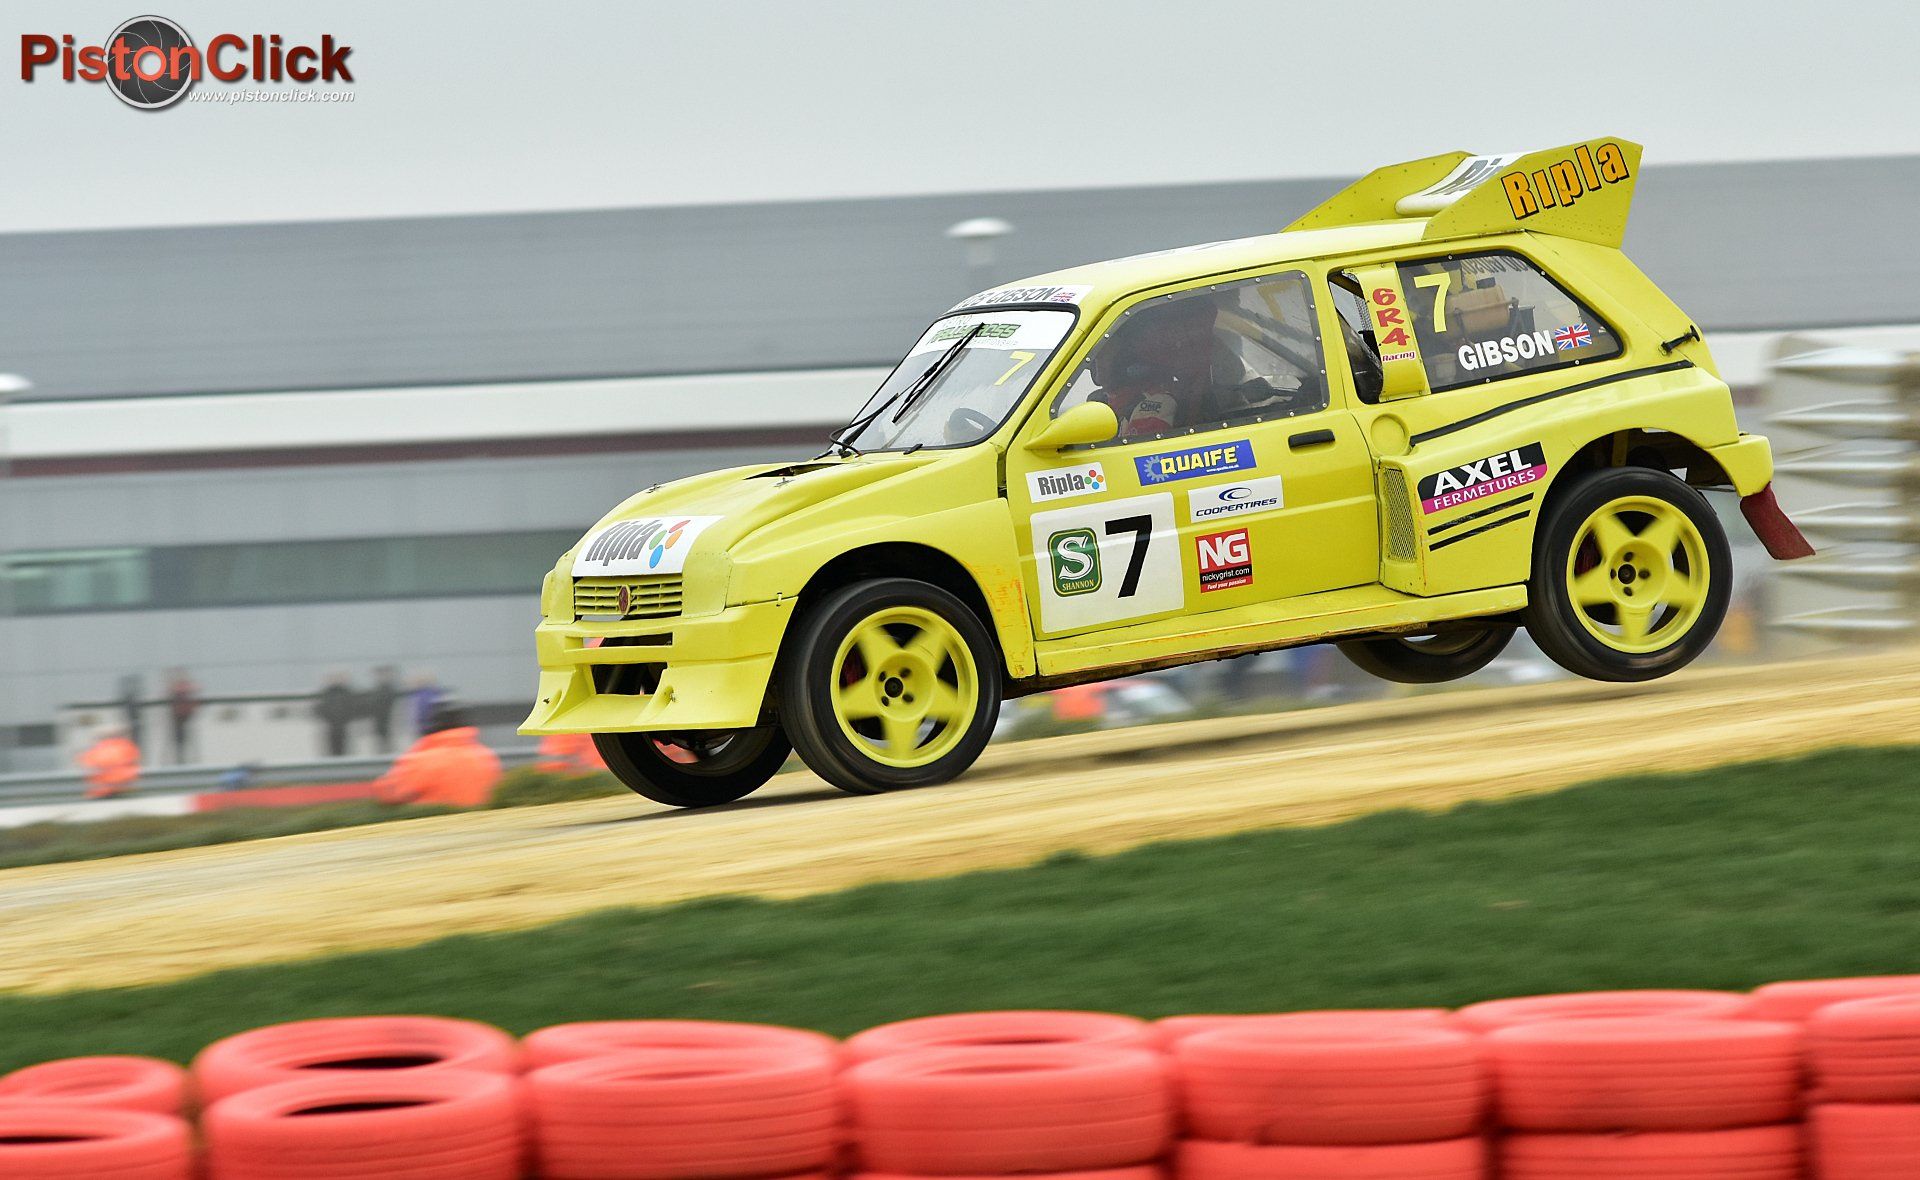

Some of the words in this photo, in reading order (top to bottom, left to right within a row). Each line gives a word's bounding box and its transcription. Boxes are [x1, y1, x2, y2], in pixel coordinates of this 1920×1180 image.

[1501, 143, 1630, 220] Ripla
[986, 287, 1063, 304] GIBSON
[1413, 272, 1451, 333] 7
[1372, 288, 1411, 346] 6R4
[994, 351, 1036, 386] 7
[1382, 351, 1415, 362] Racing
[1458, 330, 1555, 371] GIBSON
[1160, 447, 1238, 475] QUAIFE
[1433, 450, 1532, 497] AXEL
[1037, 473, 1085, 496] Ripla
[1433, 470, 1536, 510] FERMETURES
[585, 519, 664, 566] Ripla
[1057, 536, 1093, 580] S
[1105, 514, 1153, 598] 7
[1198, 533, 1248, 569] NG
[1062, 579, 1095, 592] SHANNON
[1202, 567, 1250, 582] nickygrist.com
